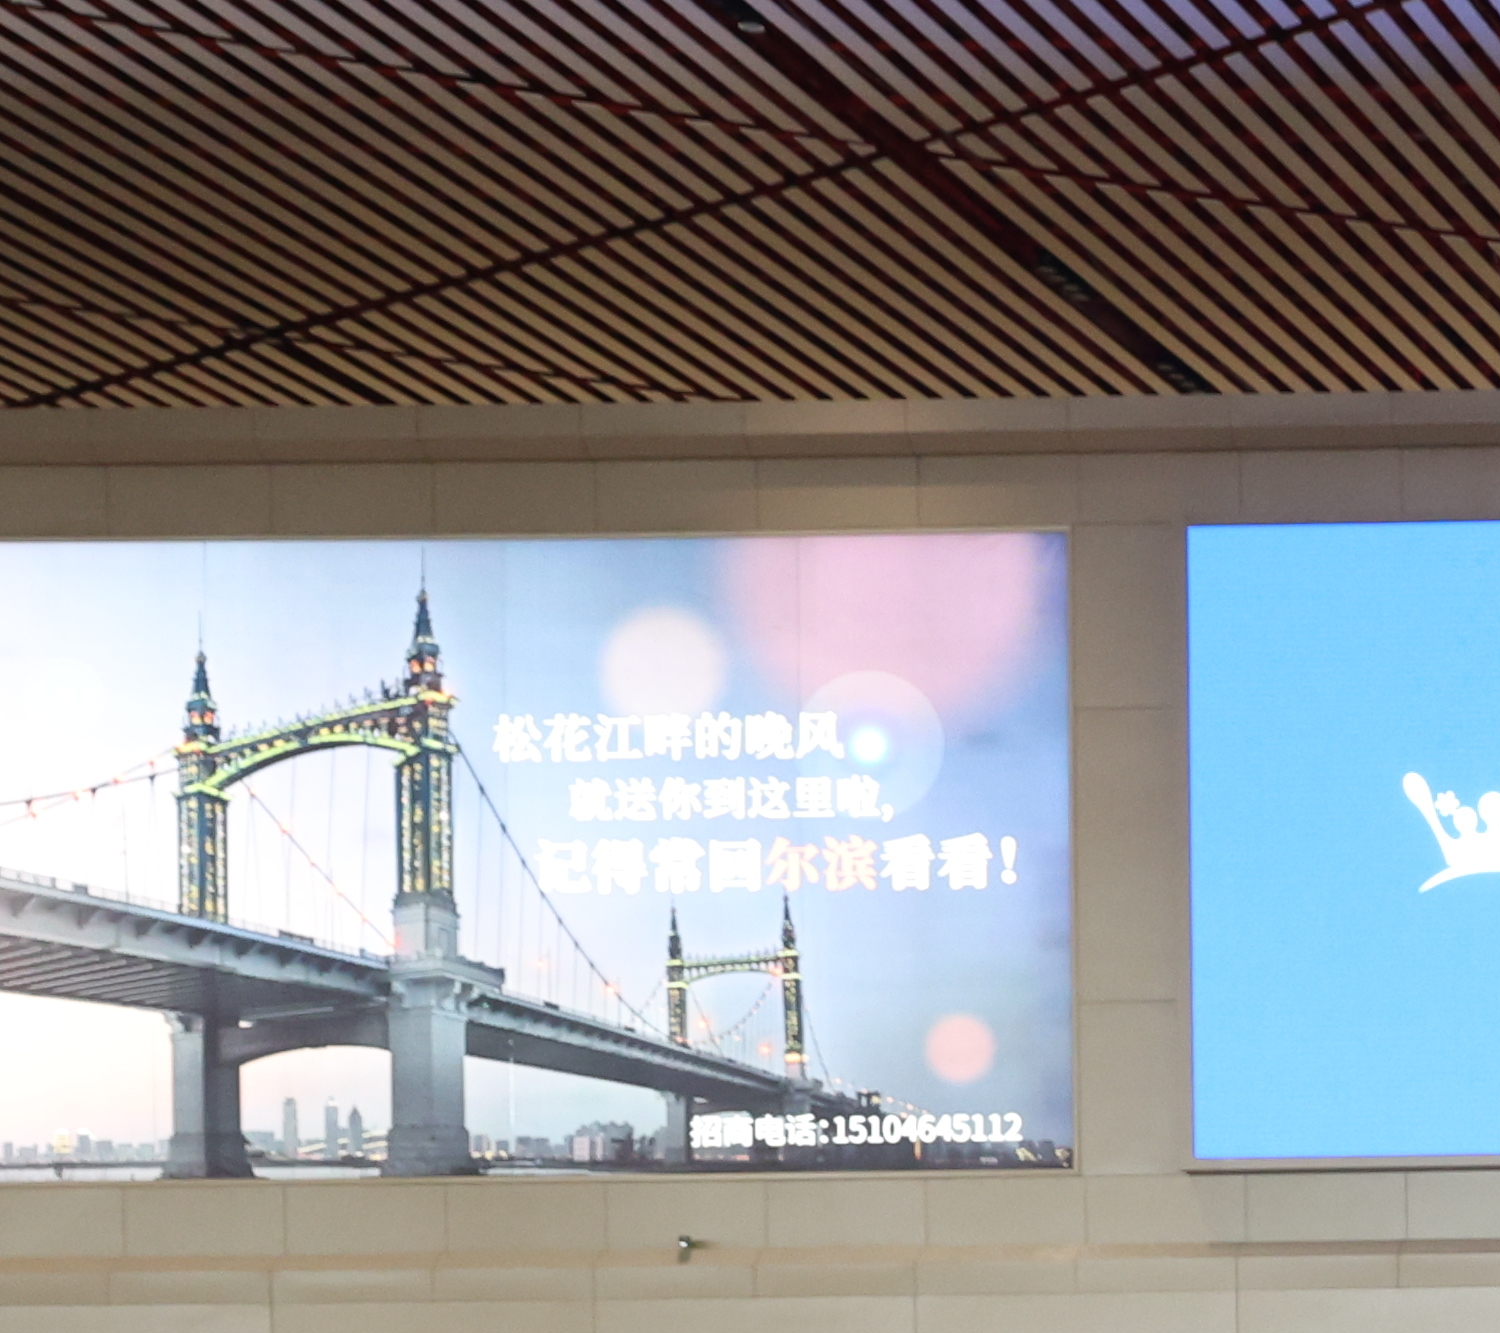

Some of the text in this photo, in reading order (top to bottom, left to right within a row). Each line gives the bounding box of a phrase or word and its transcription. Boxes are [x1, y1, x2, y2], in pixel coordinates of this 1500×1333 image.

[492, 709, 845, 764] 松花江畔的晚风
